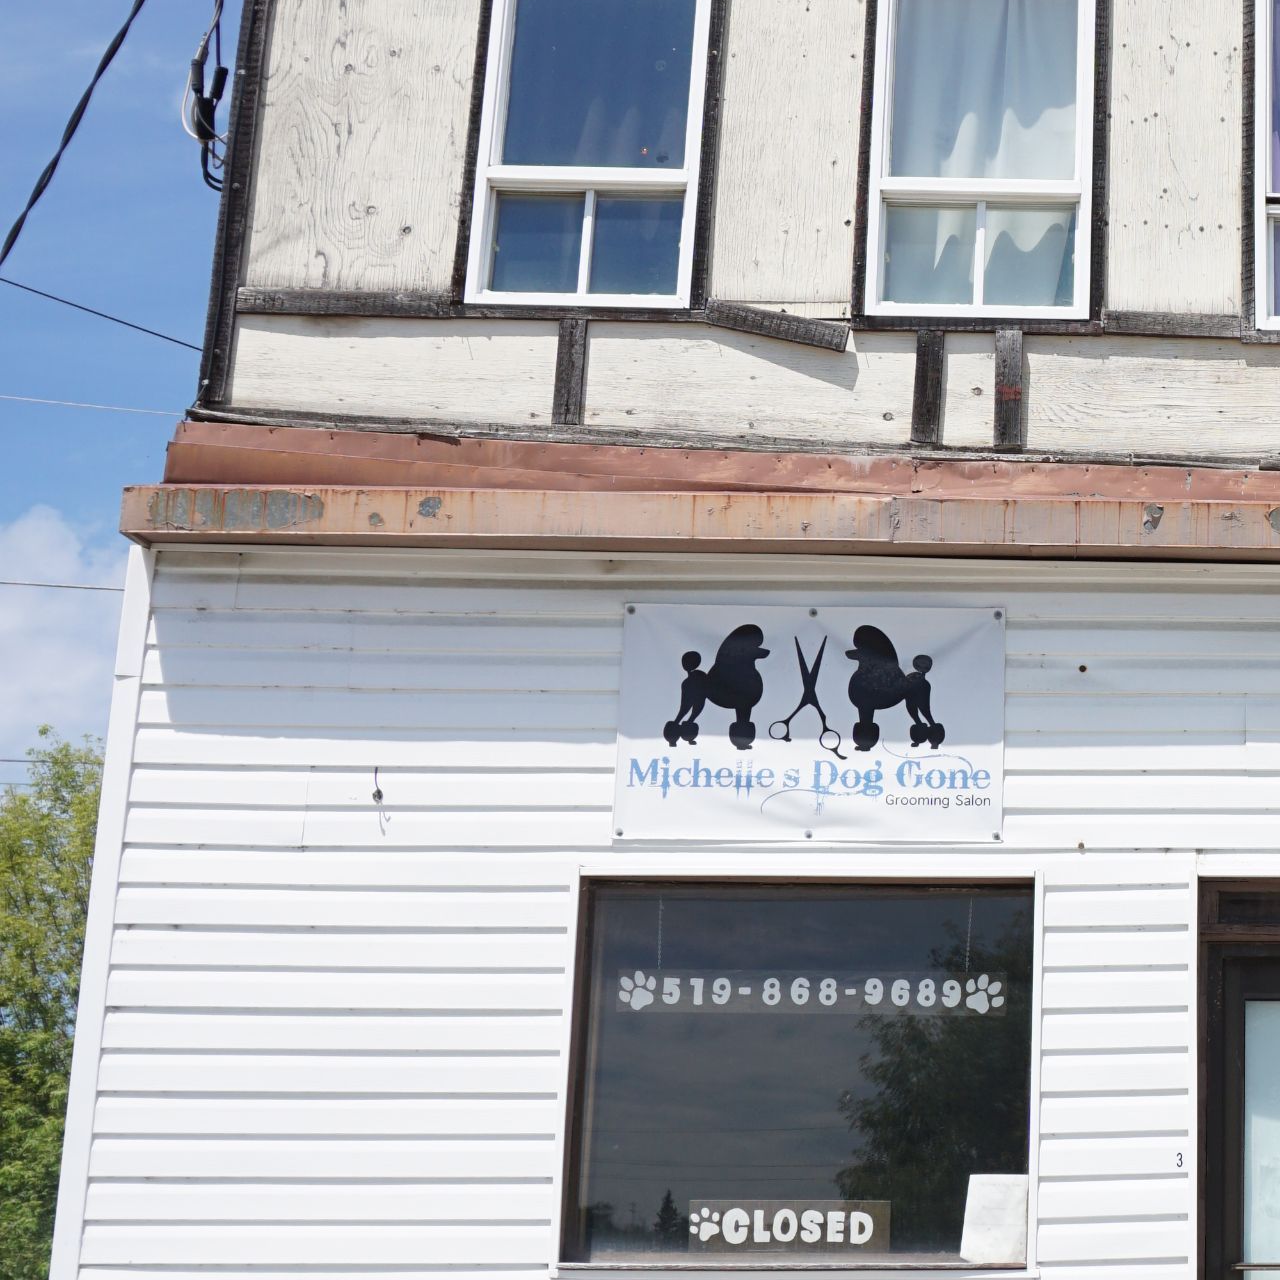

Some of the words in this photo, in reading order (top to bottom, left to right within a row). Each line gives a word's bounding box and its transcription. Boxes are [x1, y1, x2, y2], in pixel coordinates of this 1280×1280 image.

[626, 756, 800, 796] Michelles
[812, 758, 884, 798] Dog
[896, 757, 991, 790] Gone
[885, 794, 950, 809] Grooming
[956, 795, 991, 808] Salon
[661, 977, 962, 1007] 519-868-9689
[1176, 1152, 1183, 1168] 3
[722, 1208, 874, 1245] CLOSED
